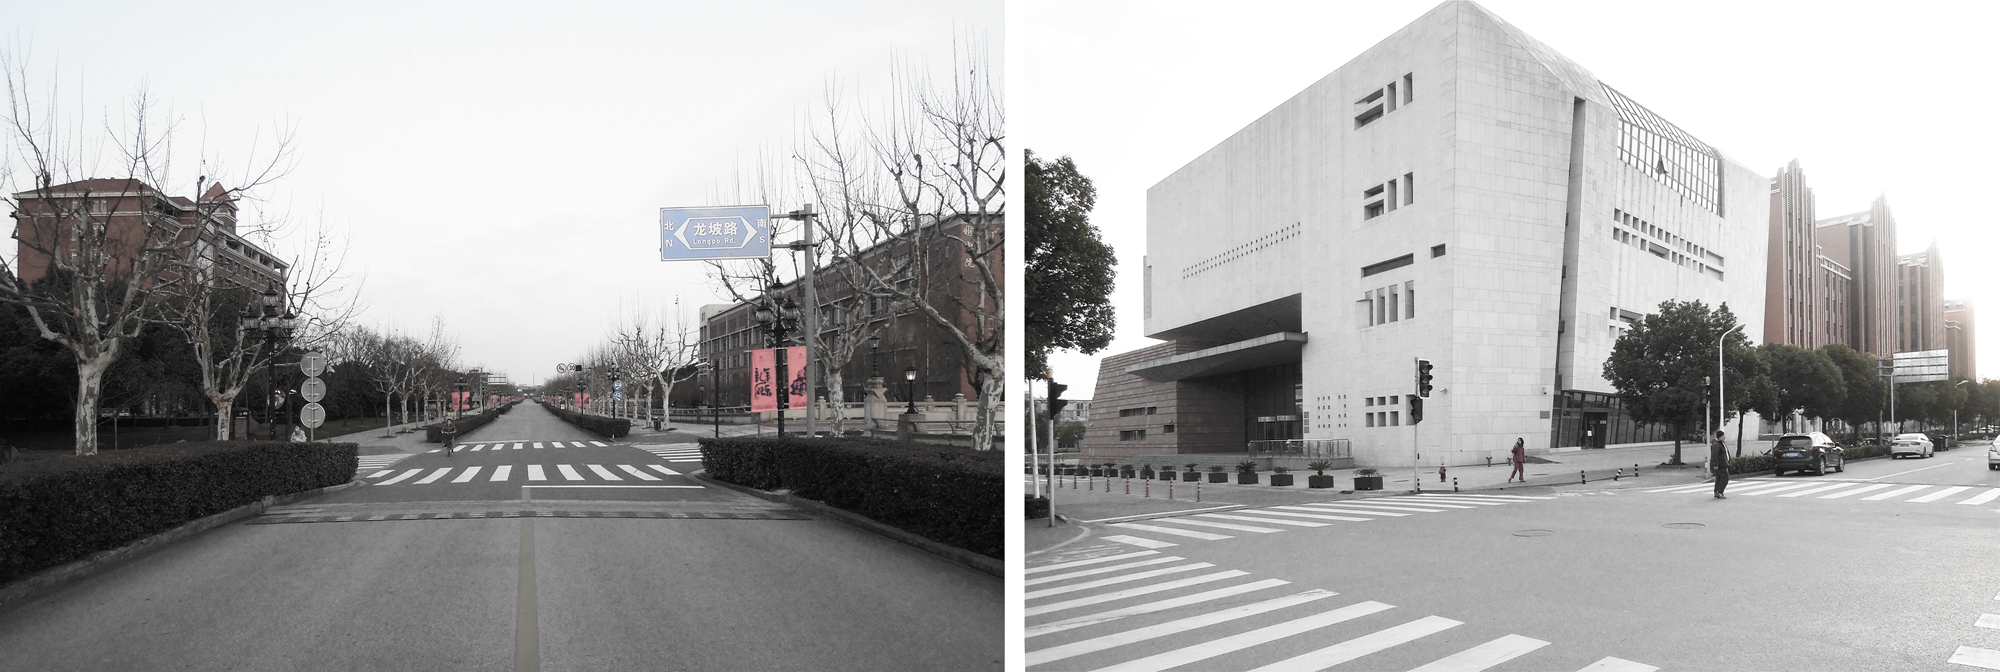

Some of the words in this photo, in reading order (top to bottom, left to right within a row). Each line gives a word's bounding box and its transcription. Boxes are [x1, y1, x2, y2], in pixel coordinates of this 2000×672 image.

[664, 221, 674, 231] 北
[757, 218, 767, 229] 南
[693, 222, 738, 236] 龙坡路
[665, 239, 673, 247] N
